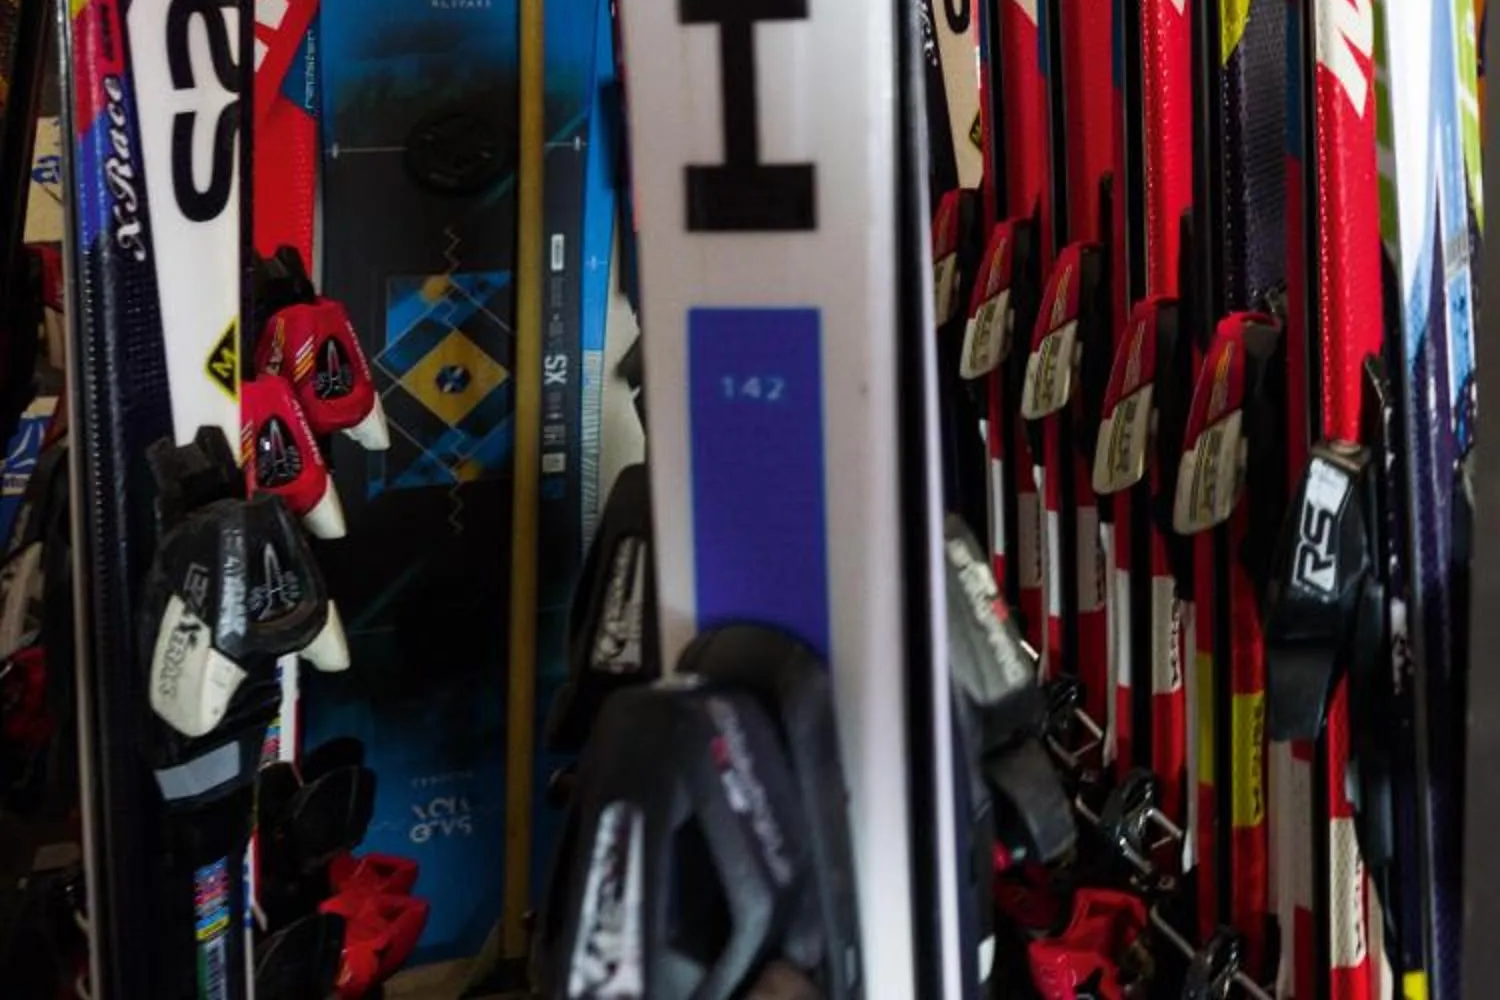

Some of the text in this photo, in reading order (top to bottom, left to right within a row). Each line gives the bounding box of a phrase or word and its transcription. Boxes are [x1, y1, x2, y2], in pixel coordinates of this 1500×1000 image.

[544, 353, 568, 385] XS
[721, 375, 785, 400] 142
[1296, 504, 1337, 582] RS
